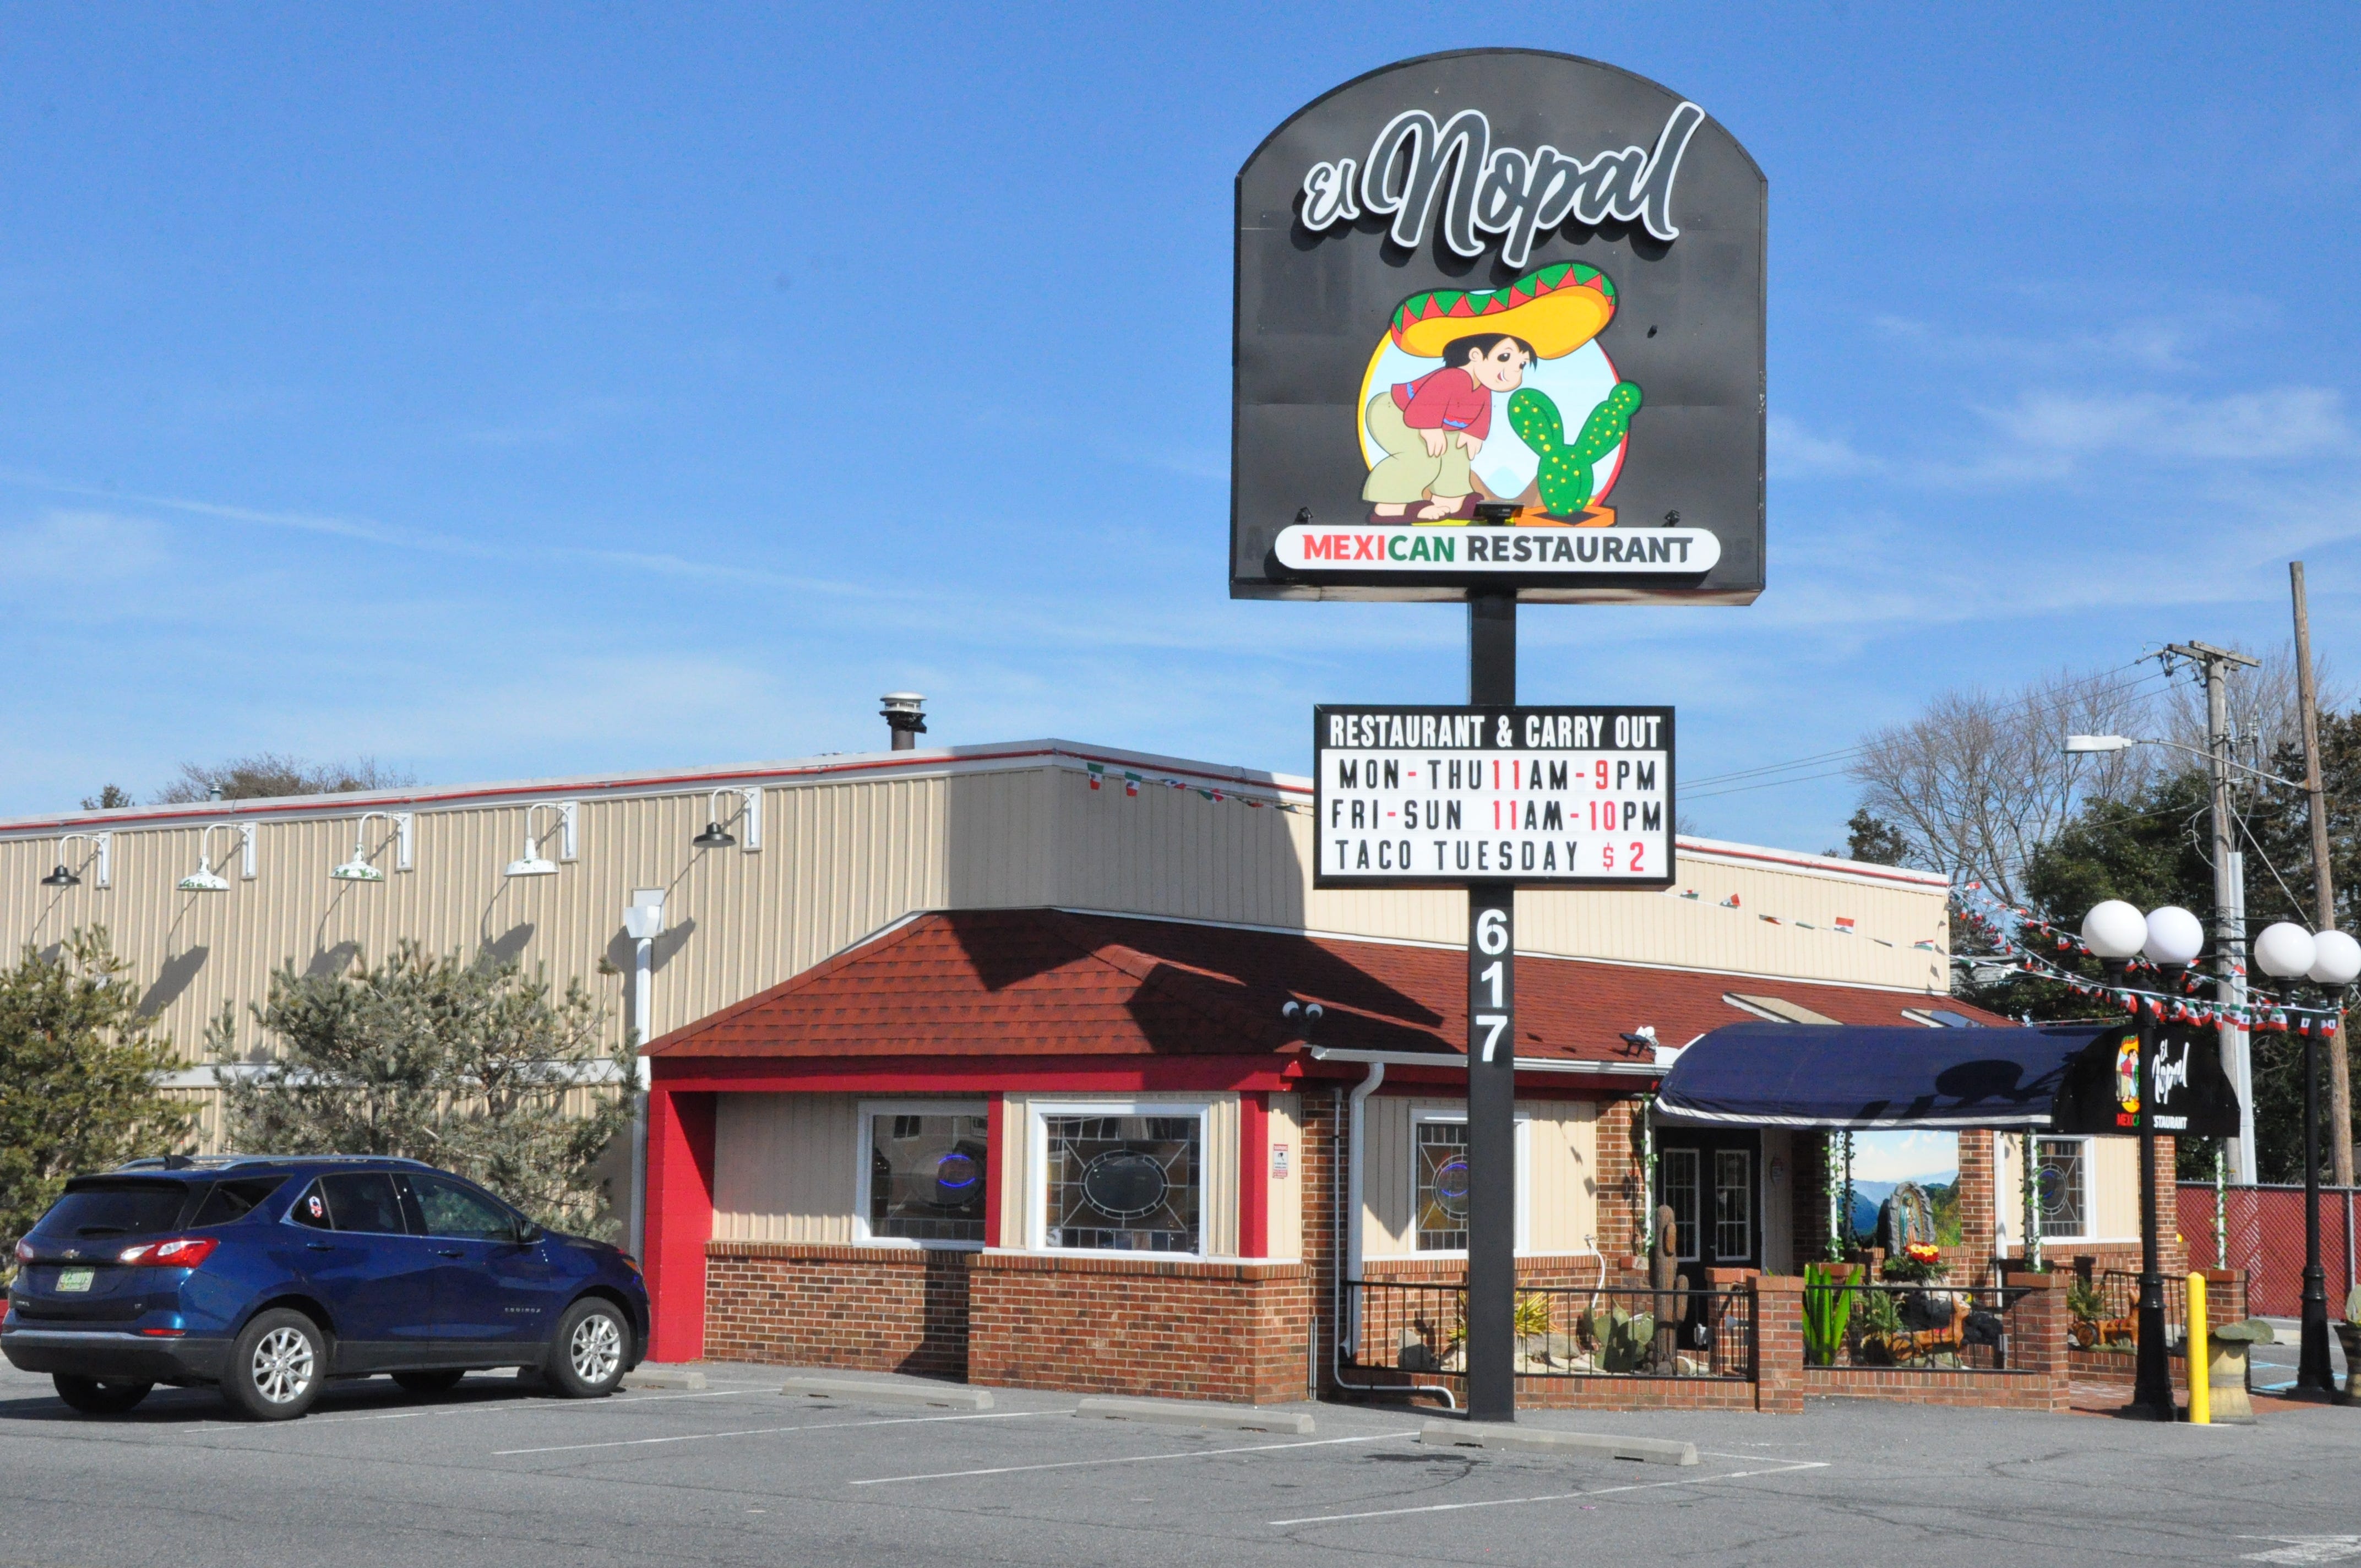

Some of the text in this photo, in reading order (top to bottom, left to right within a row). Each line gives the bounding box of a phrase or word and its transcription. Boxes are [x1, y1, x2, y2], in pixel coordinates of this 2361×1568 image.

[1302, 101, 1705, 268] El Nopal
[1303, 535, 1693, 563] MEXICAN RESTAURANT
[1330, 715, 1661, 749] RESTAURANT & CARRY OUT
[1332, 799, 1661, 831] FRI-SUN 11AM-10PM
[1335, 840, 1411, 870] TACO
[1434, 841, 1577, 871] TUESDAY
[2160, 1039, 2168, 1062] El
[2117, 1113, 2188, 1129] MEXIC STAURANT
